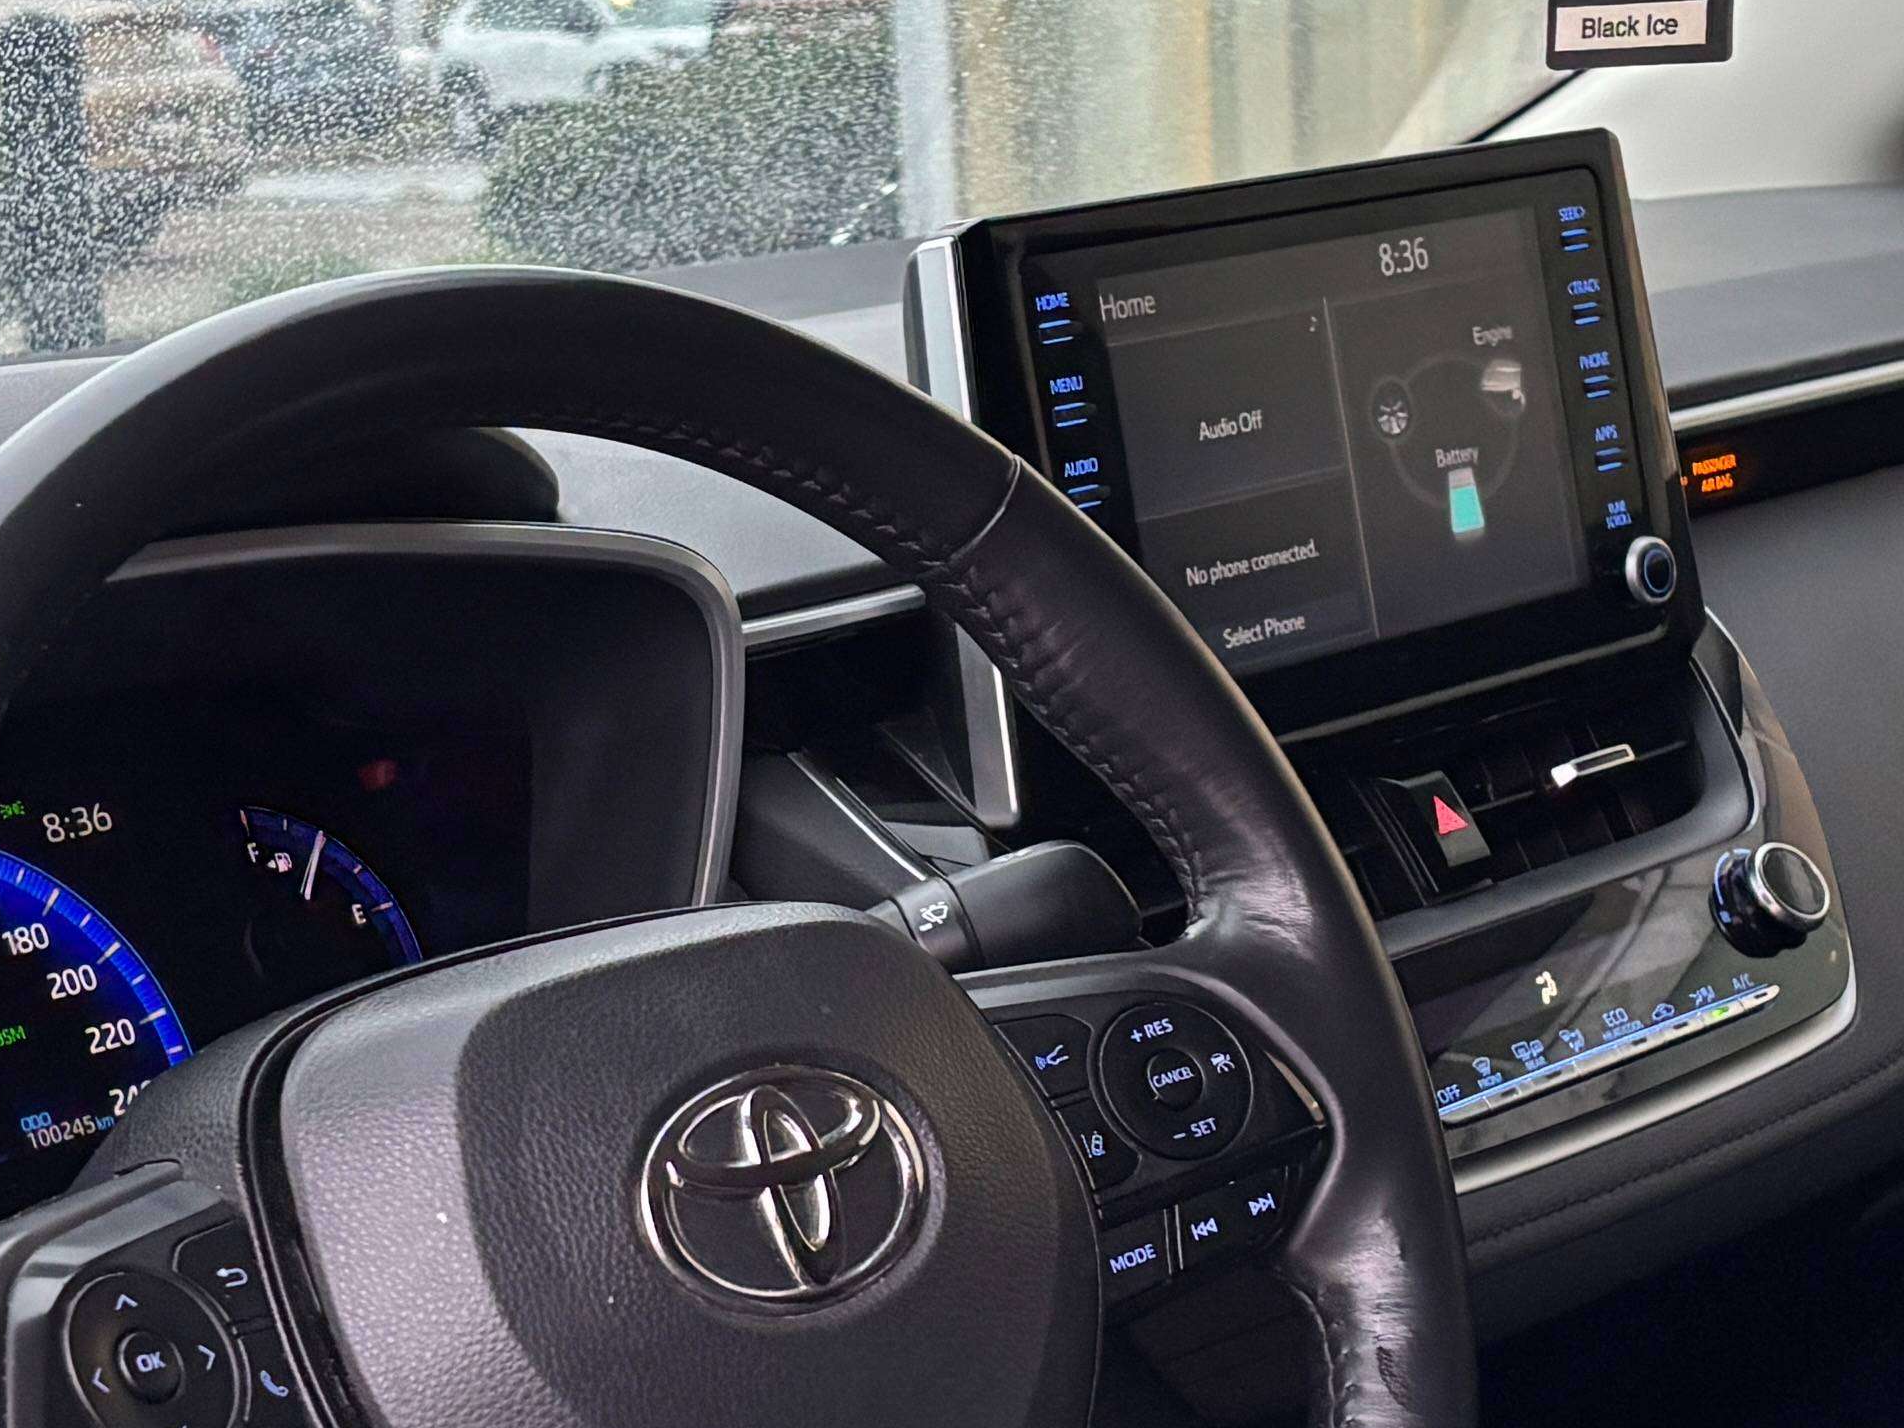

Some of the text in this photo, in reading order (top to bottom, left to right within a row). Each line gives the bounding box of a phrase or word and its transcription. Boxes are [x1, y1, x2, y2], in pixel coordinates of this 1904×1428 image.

[1581, 13, 1680, 40] Black Ice
[1378, 237, 1429, 276] 8:36
[1035, 291, 1070, 311] HOME
[1099, 292, 1156, 322] Home
[1050, 375, 1084, 395] MENU
[1199, 409, 1264, 441] Audio Off
[1064, 457, 1099, 478] AUDIO
[1435, 445, 1479, 468] Battery
[1186, 538, 1320, 587] No phone connected.
[1223, 613, 1306, 649] Select Phone
[41, 803, 113, 843] 8:36
[247, 841, 260, 864] F
[352, 904, 367, 925] E
[1, 923, 50, 957] 180
[46, 964, 98, 1000] 200
[1602, 1007, 1629, 1027] ECO
[84, 1018, 136, 1054] 220
[1152, 1065, 1195, 1089] CANCEL
[1437, 1084, 1461, 1104] OFF
[27, 1114, 97, 1149] 100245
[1110, 1243, 1157, 1274] MODE
[136, 1350, 166, 1373] OK
